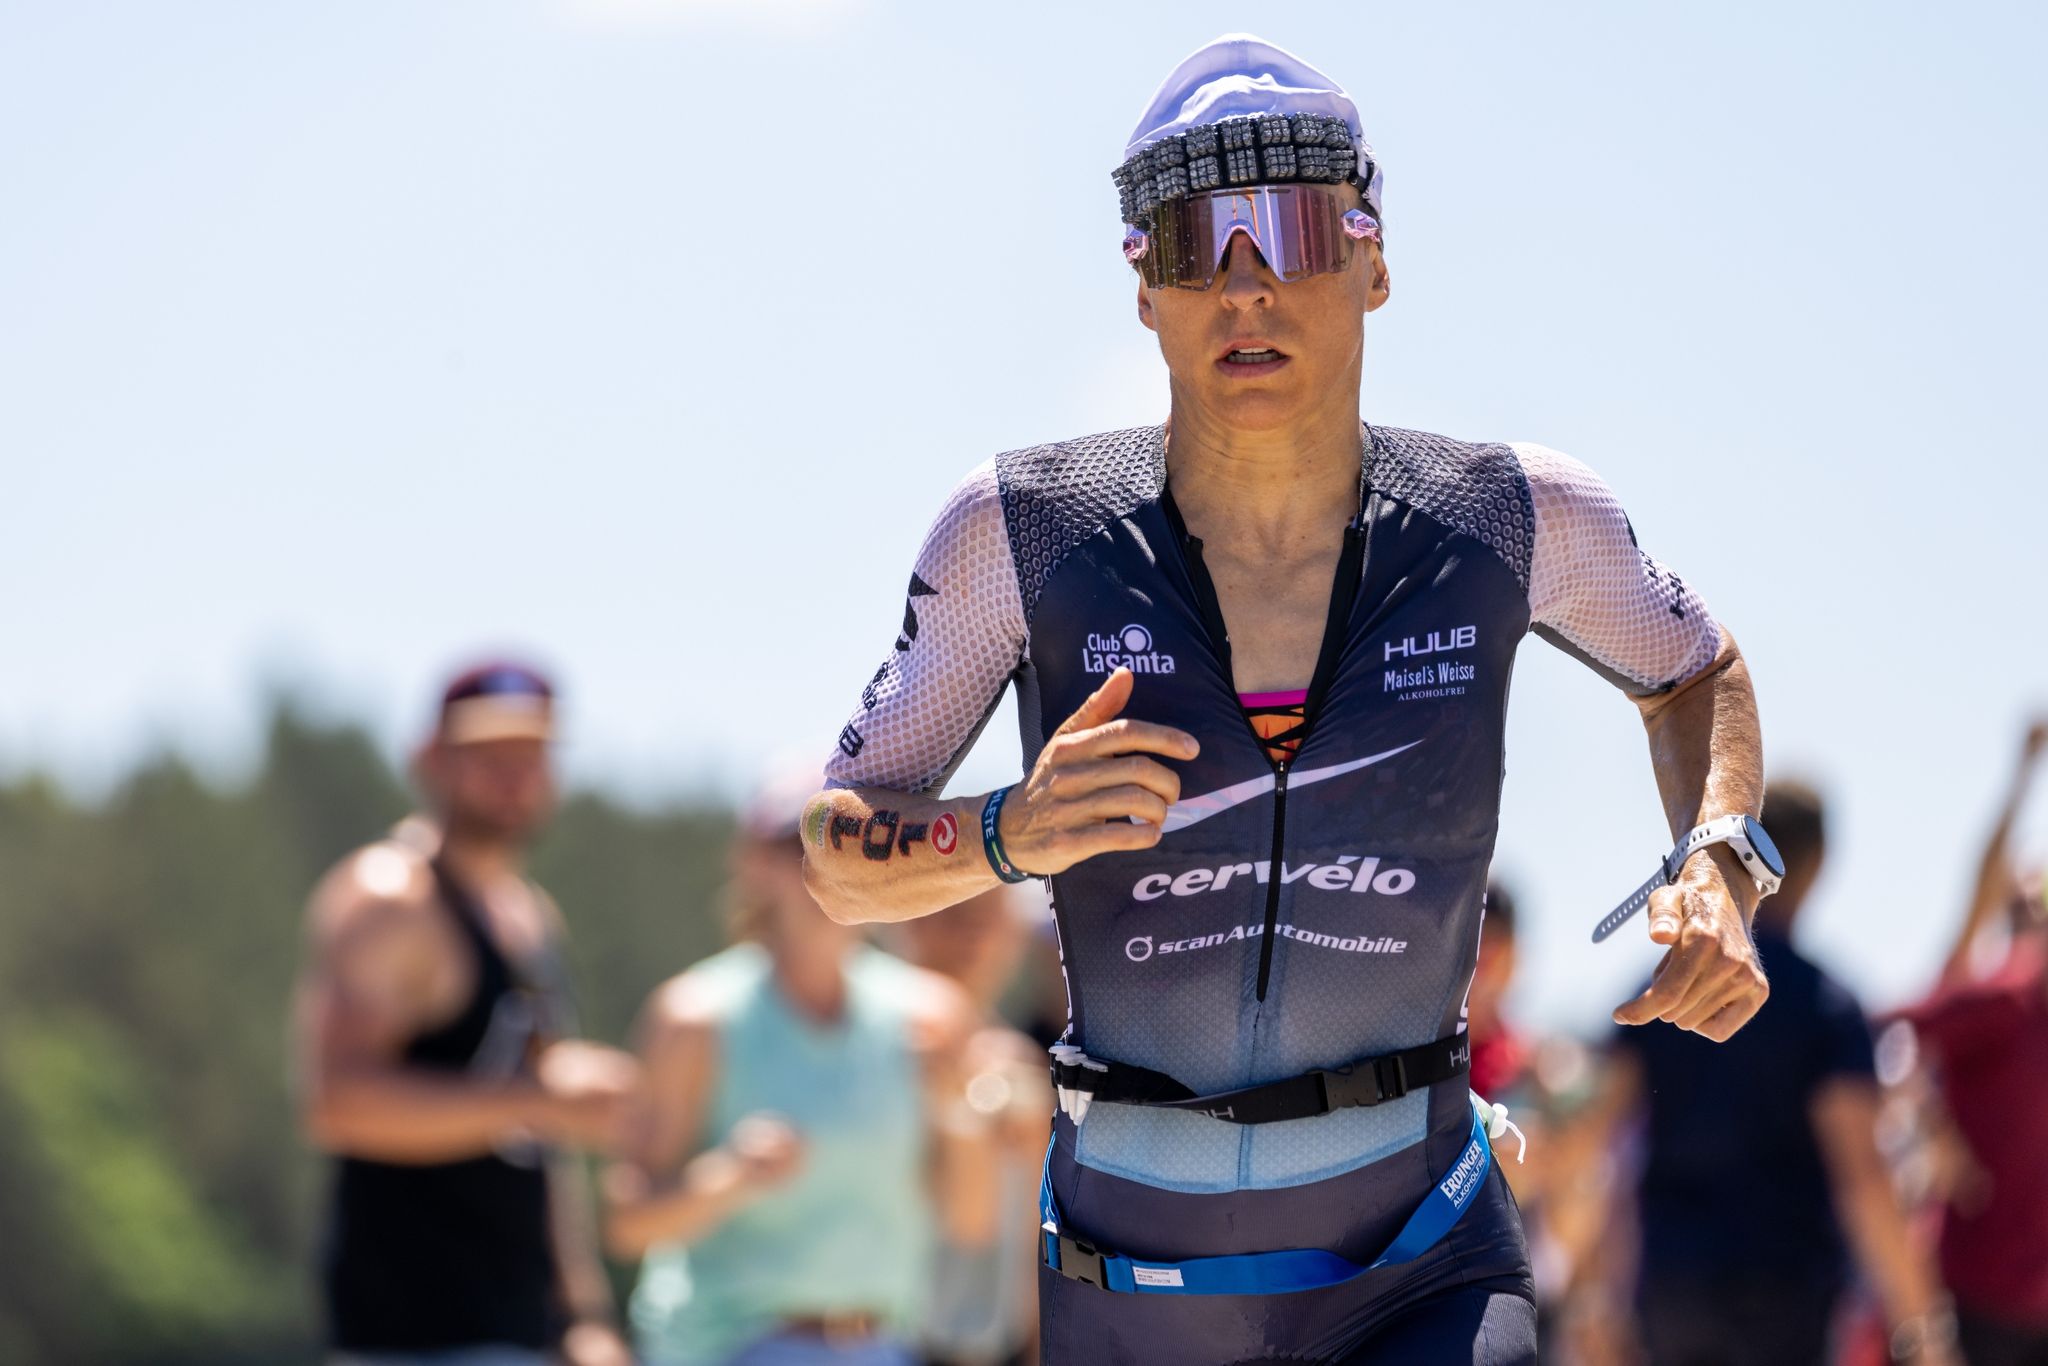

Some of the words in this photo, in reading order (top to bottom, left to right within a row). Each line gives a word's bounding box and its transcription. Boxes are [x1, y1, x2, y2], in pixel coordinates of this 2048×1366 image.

[1087, 633, 1121, 652] Club
[1384, 625, 1477, 662] HUUB
[1383, 665, 1435, 693] Maisel's
[1437, 661, 1475, 684] Weisse
[1398, 686, 1466, 702] ALKOHOLFREI
[985, 788, 1007, 839] HLETE
[1132, 855, 1416, 901] cervélo
[1158, 924, 1408, 954] scanAutomobile
[1449, 1046, 1471, 1068] HU
[1440, 1140, 1482, 1199] ERDINGER
